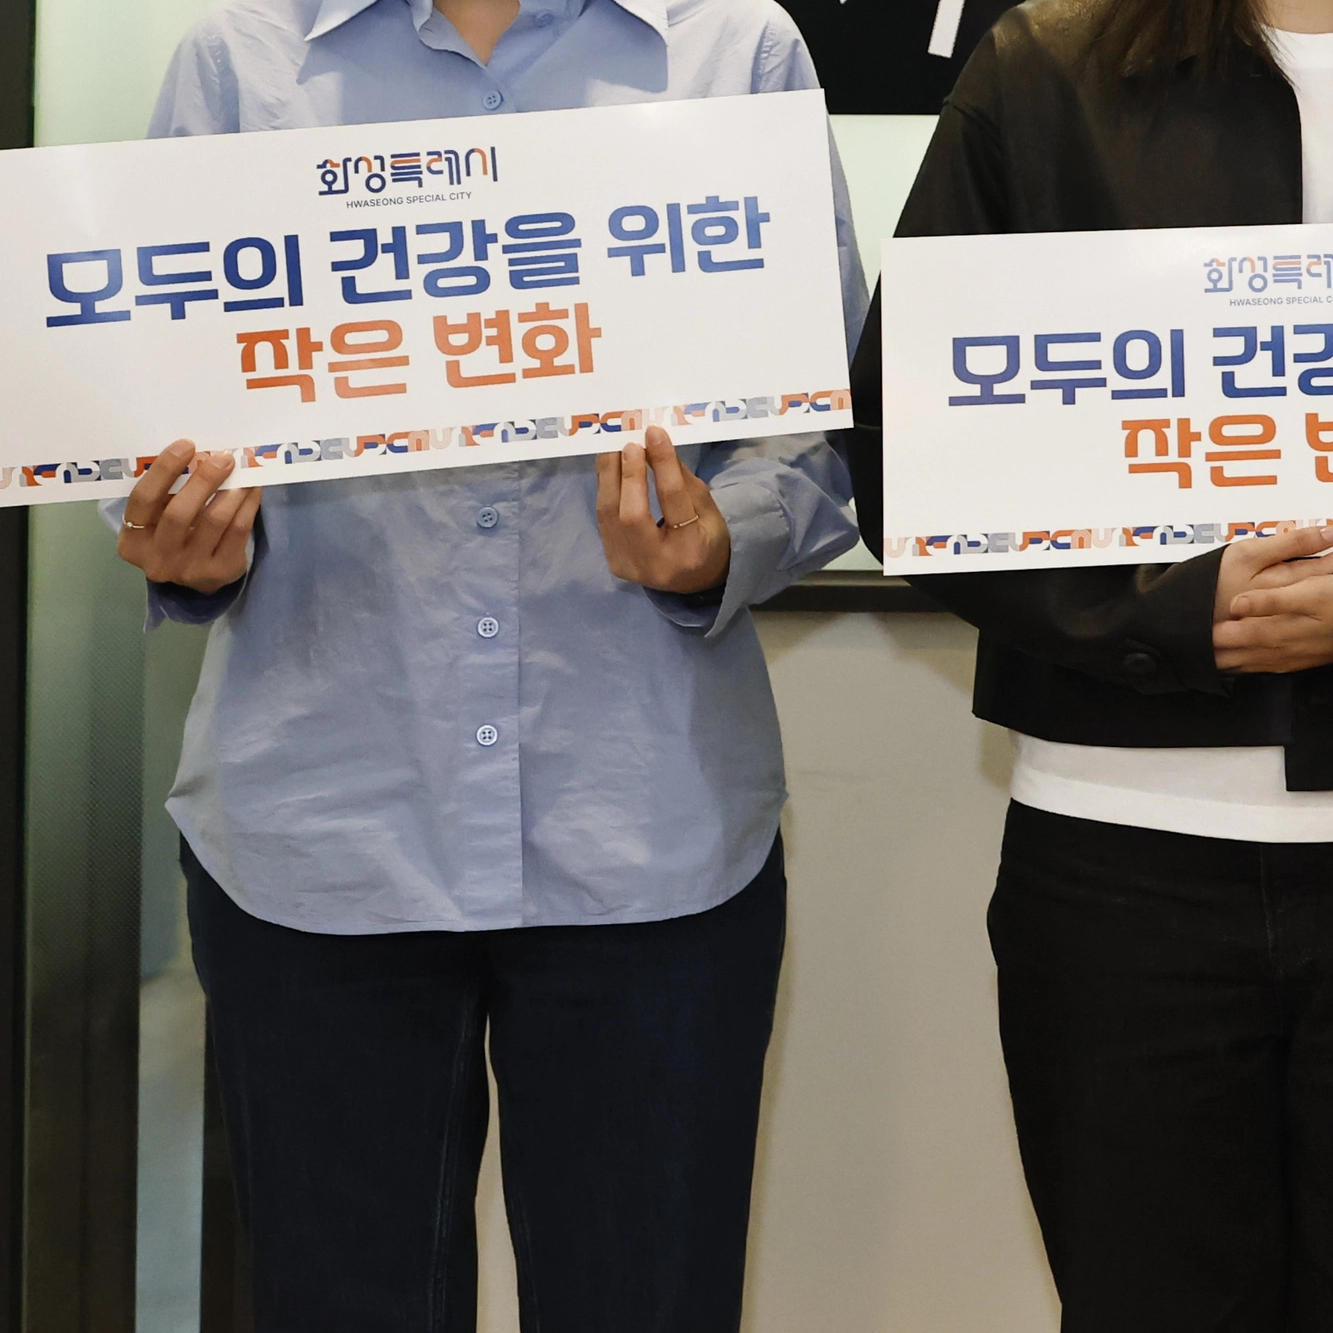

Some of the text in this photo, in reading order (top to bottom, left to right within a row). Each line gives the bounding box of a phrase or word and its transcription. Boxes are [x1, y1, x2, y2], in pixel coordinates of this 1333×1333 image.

[316, 146, 498, 196] 화성특례시
[346, 191, 472, 209] HWASEONG SPECIAL CITY
[46, 195, 771, 328] 모두의 건강을 위한
[1229, 297, 1284, 307] HWASEONG
[1285, 296, 1324, 305] SPECIAL
[236, 302, 602, 403] 작은 변화
[948, 328, 1185, 407] 모두의
[1121, 414, 1282, 490] 작은
